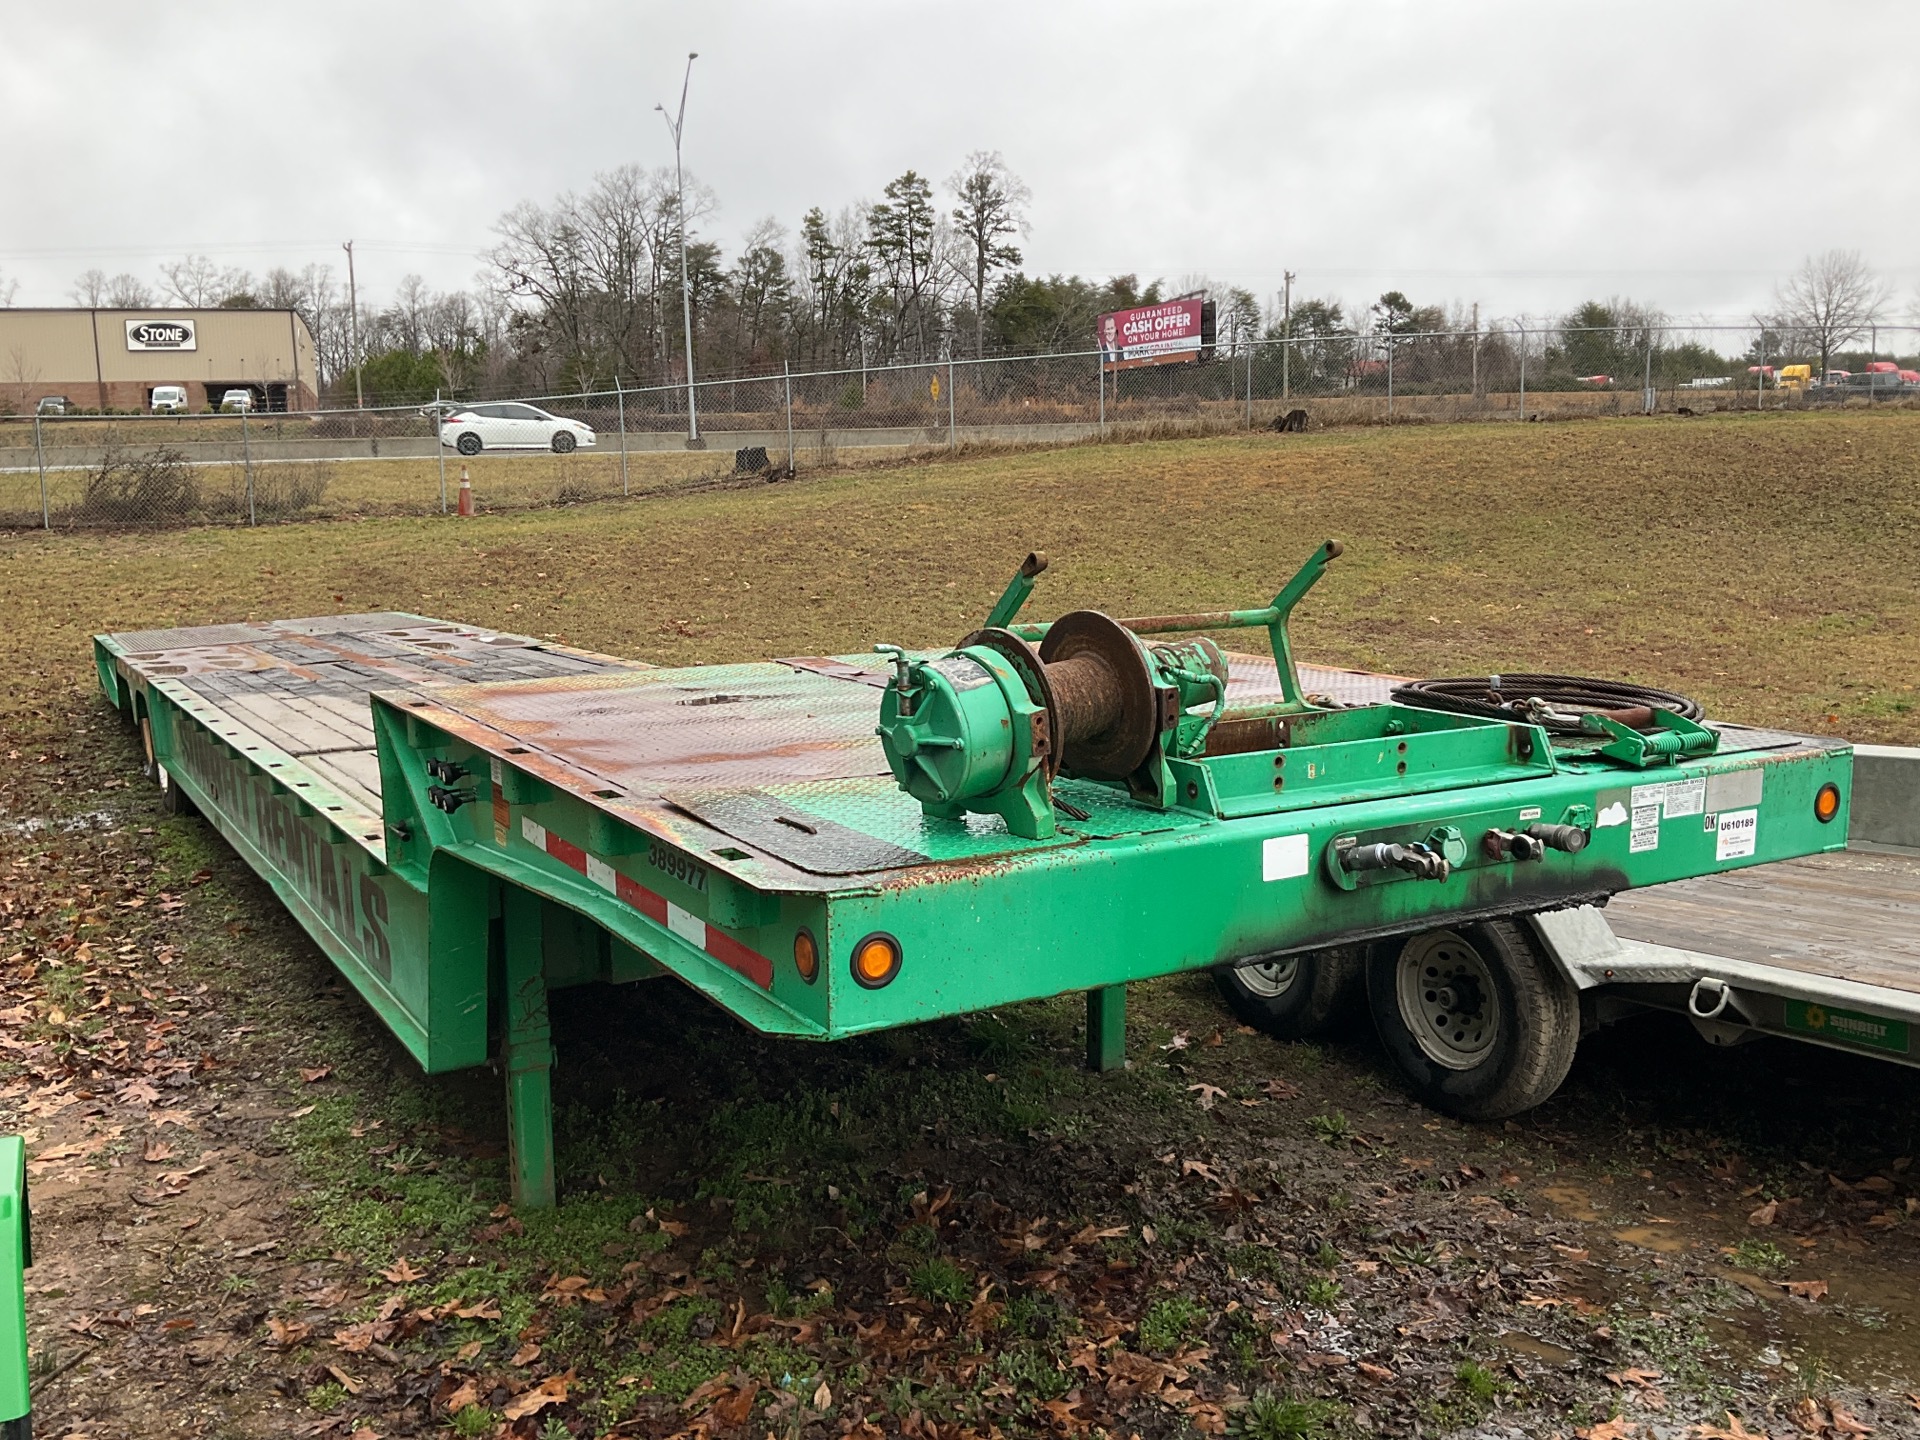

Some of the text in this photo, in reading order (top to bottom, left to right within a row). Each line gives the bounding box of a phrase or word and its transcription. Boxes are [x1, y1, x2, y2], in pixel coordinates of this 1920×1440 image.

[1130, 306, 1183, 321] GUARANTEED
[1123, 313, 1191, 336] CASH OFFER
[139, 326, 183, 341] STONE
[1128, 328, 1186, 344] ON YOUR HOME!
[1704, 815, 1716, 830] OK
[1721, 817, 1754, 831] U610189
[648, 843, 707, 890] 389977
[254, 781, 392, 984] RENTALS
